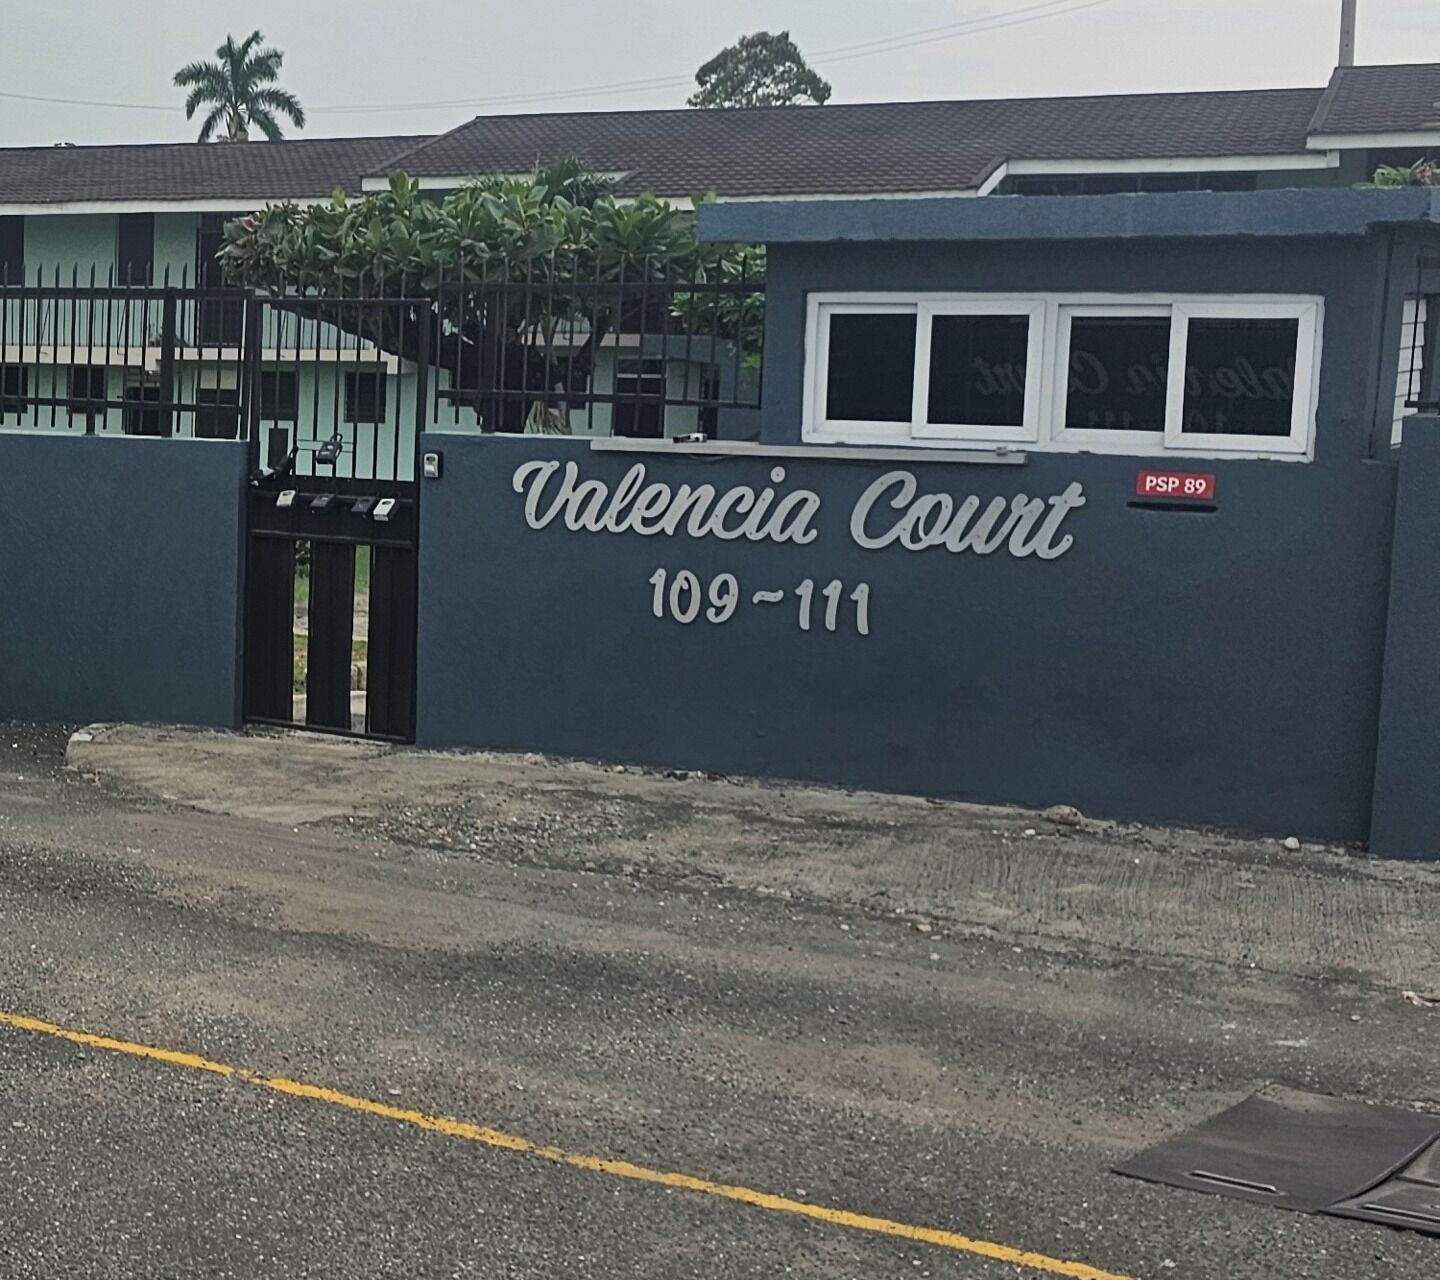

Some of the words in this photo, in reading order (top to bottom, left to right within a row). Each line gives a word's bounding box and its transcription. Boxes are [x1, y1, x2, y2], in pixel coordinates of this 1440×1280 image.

[511, 460, 820, 545] Valencia
[849, 470, 1087, 560] Court
[1144, 475, 1180, 493] PSP
[1183, 478, 1207, 495] 89
